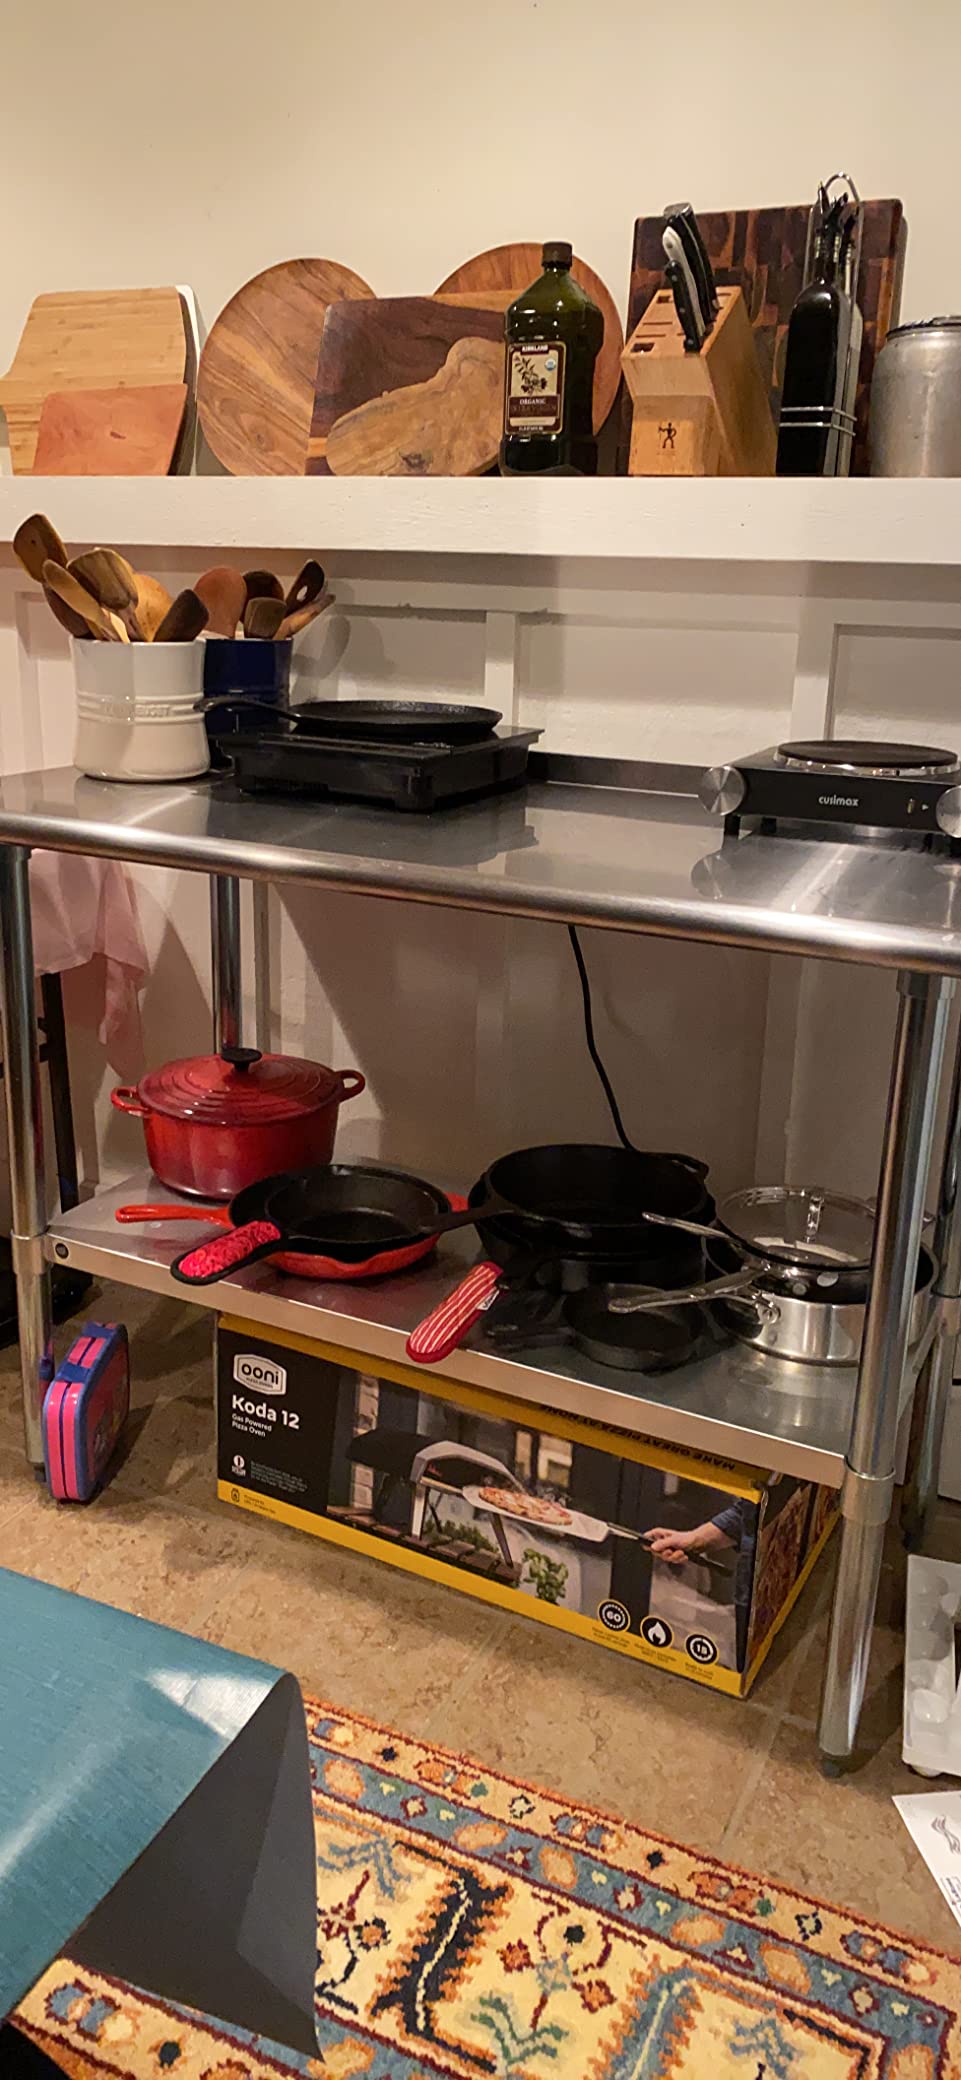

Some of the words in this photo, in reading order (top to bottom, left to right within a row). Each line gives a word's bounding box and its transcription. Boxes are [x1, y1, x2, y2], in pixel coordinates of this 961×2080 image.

[818, 794, 859, 806] cusimax
[241, 1363, 279, 1385] ooni
[232, 1394, 277, 1422] Koda
[281, 1409, 300, 1430] 12
[232, 1413, 244, 1422] Gas
[245, 1415, 272, 1432] Powered
[232, 1421, 248, 1432] Pizza
[249, 1426, 266, 1437] Oven
[641, 1437, 691, 1457] GREAT
[693, 1453, 736, 1471] MAKE
[606, 1610, 621, 1622] 60
